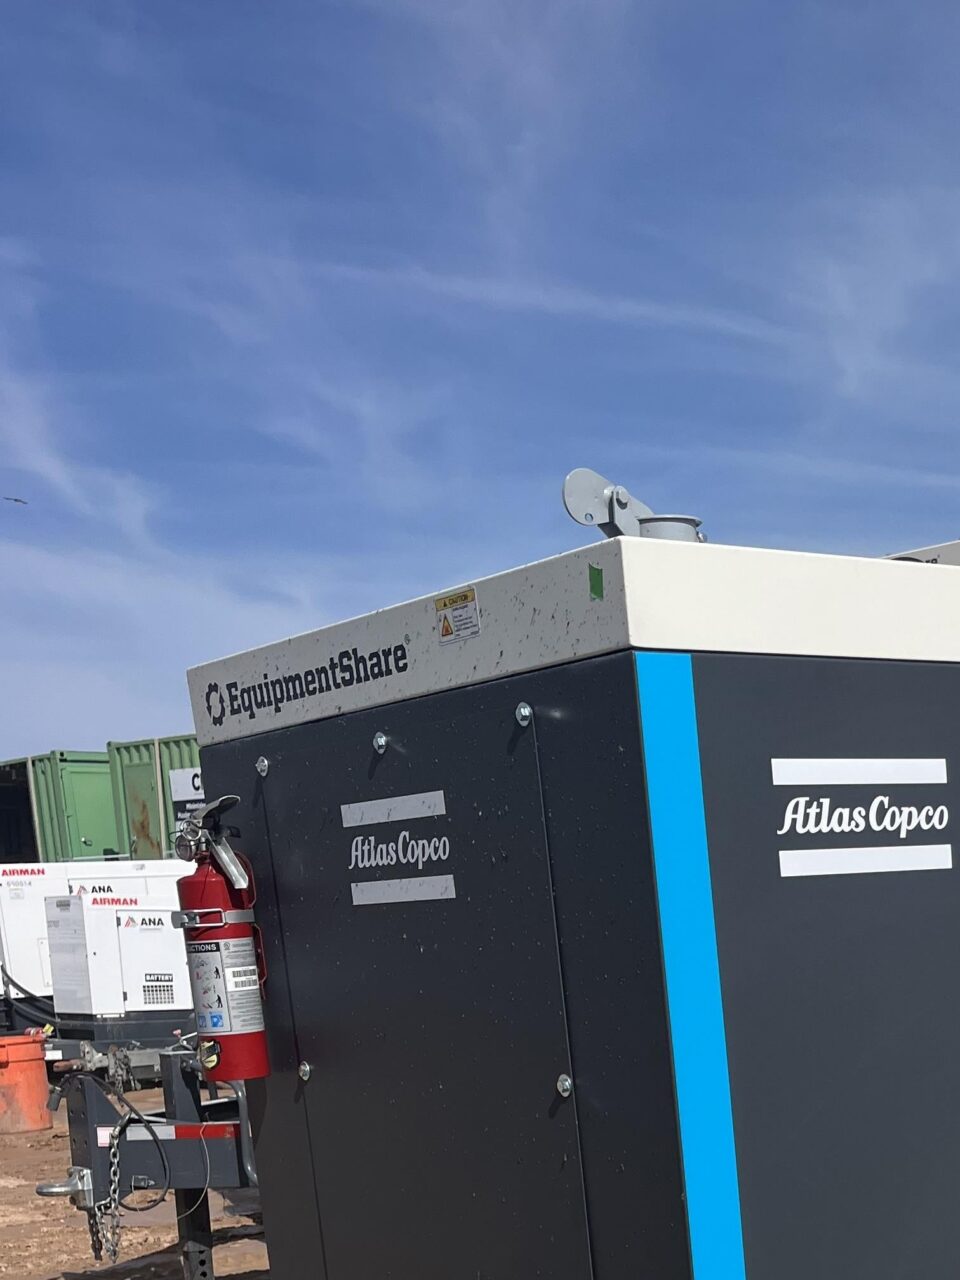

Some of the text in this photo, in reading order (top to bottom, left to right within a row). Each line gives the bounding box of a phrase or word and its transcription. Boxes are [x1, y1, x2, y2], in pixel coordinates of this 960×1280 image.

[226, 644, 408, 720] EquipmentShare
[776, 795, 949, 839] Atlas Copco
[348, 830, 450, 870] Atlas Copco
[2, 868, 45, 876] AIRMAN
[91, 886, 113, 894] ANA
[92, 898, 138, 906] AIRMAN
[140, 918, 164, 926] ANA
[146, 974, 173, 982] BATTERY
